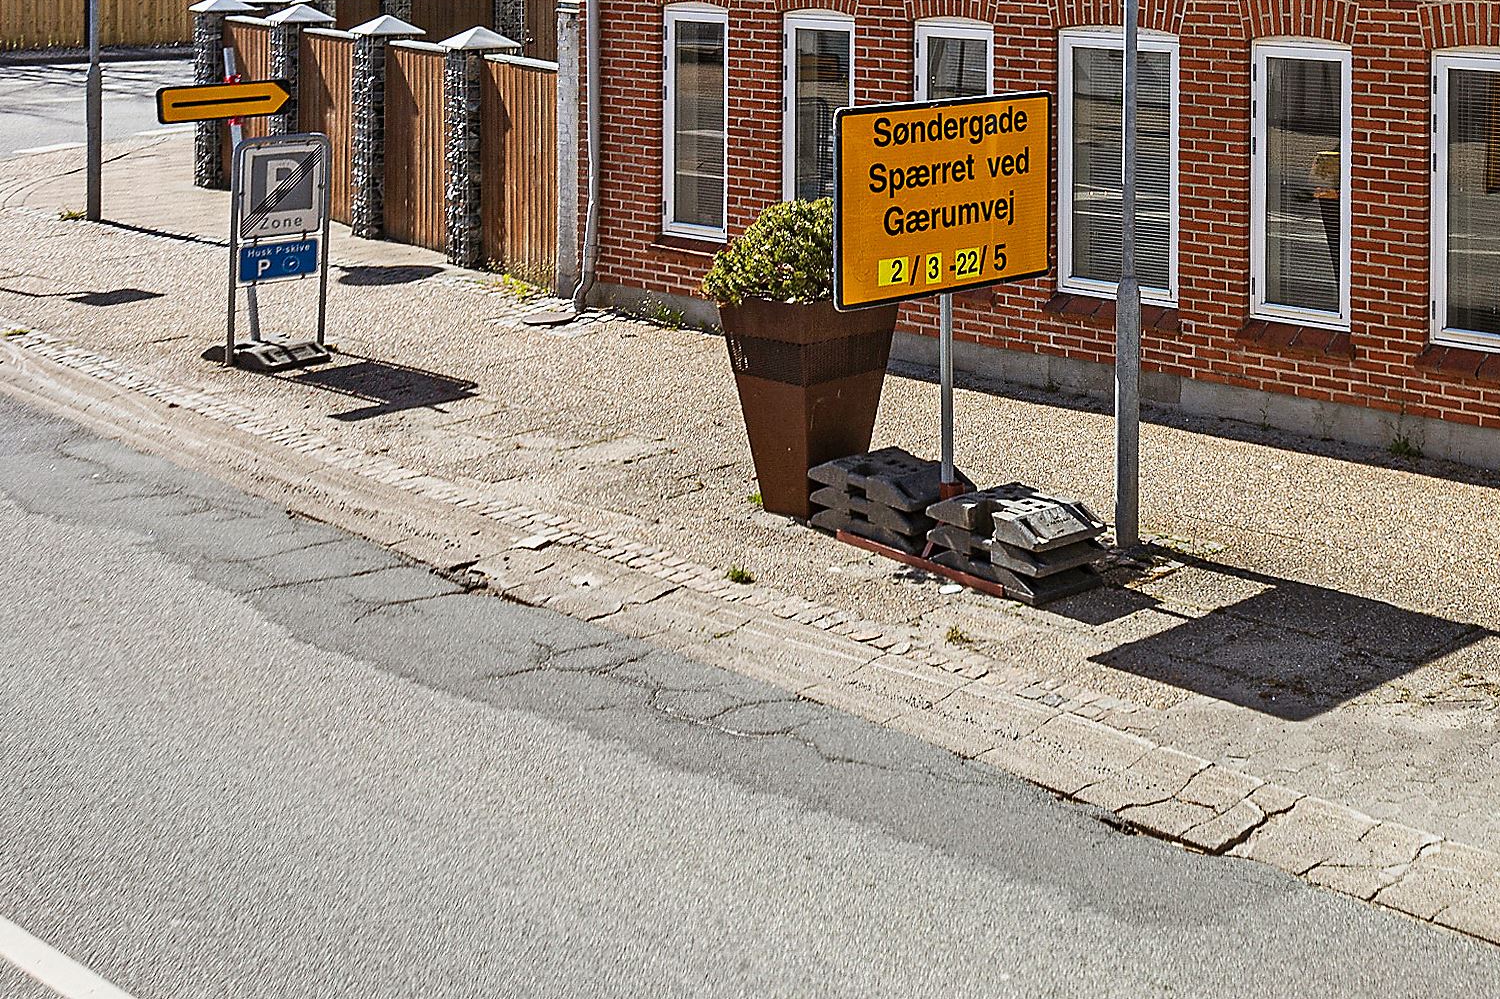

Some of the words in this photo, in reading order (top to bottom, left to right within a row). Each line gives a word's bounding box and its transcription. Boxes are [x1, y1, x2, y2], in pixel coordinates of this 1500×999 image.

[873, 106, 1028, 148] Søndergade
[868, 154, 975, 198] Spærret
[986, 146, 1030, 178] ved
[260, 216, 303, 230] Zone
[883, 190, 1015, 236] Gærumvej
[247, 248, 273, 258] Husk
[257, 258, 271, 277] P
